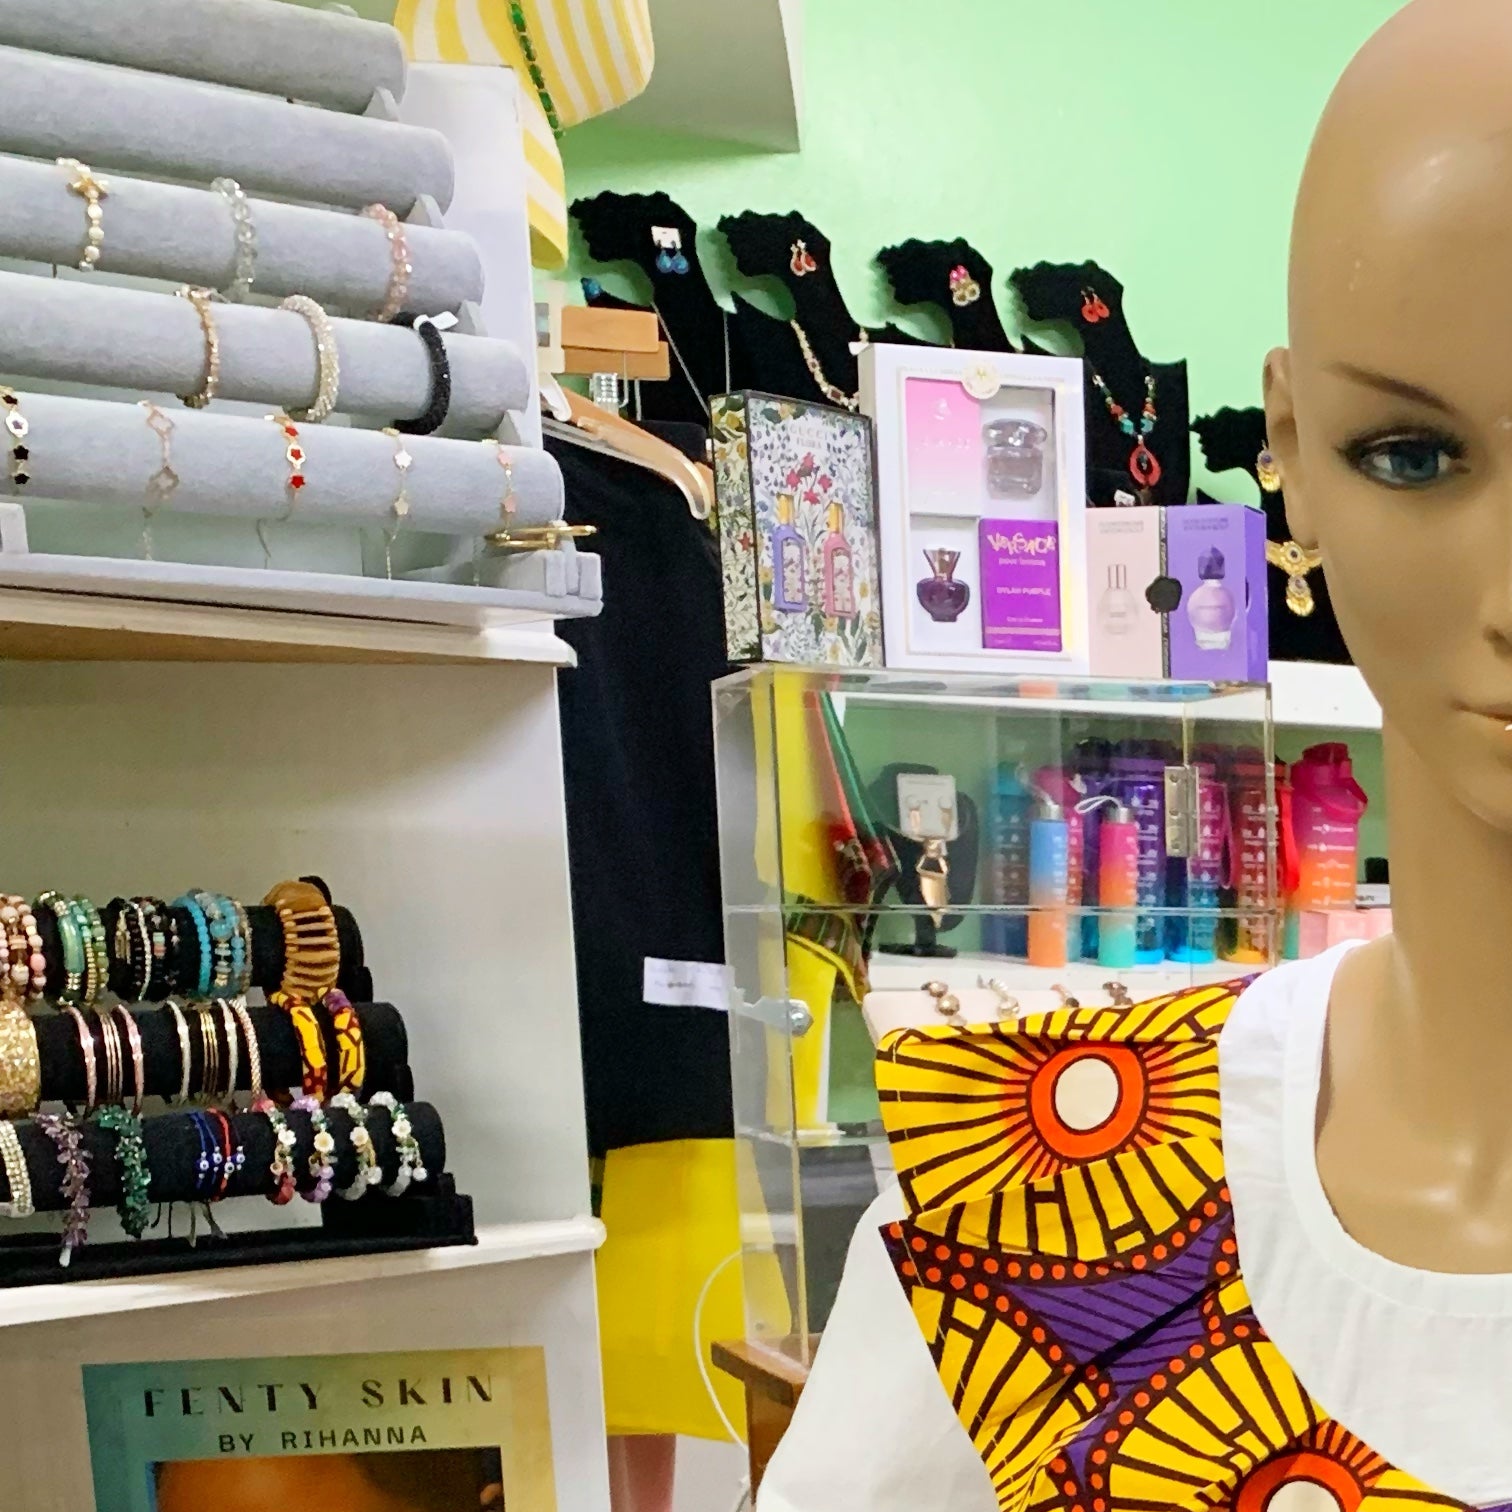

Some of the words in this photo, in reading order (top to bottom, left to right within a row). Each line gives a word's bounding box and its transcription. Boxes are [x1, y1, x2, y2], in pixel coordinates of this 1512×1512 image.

[144, 1383, 321, 1416] FENTY
[361, 1375, 493, 1408] SKIN
[218, 1433, 254, 1453] BY
[281, 1425, 427, 1449] RIHANNA
